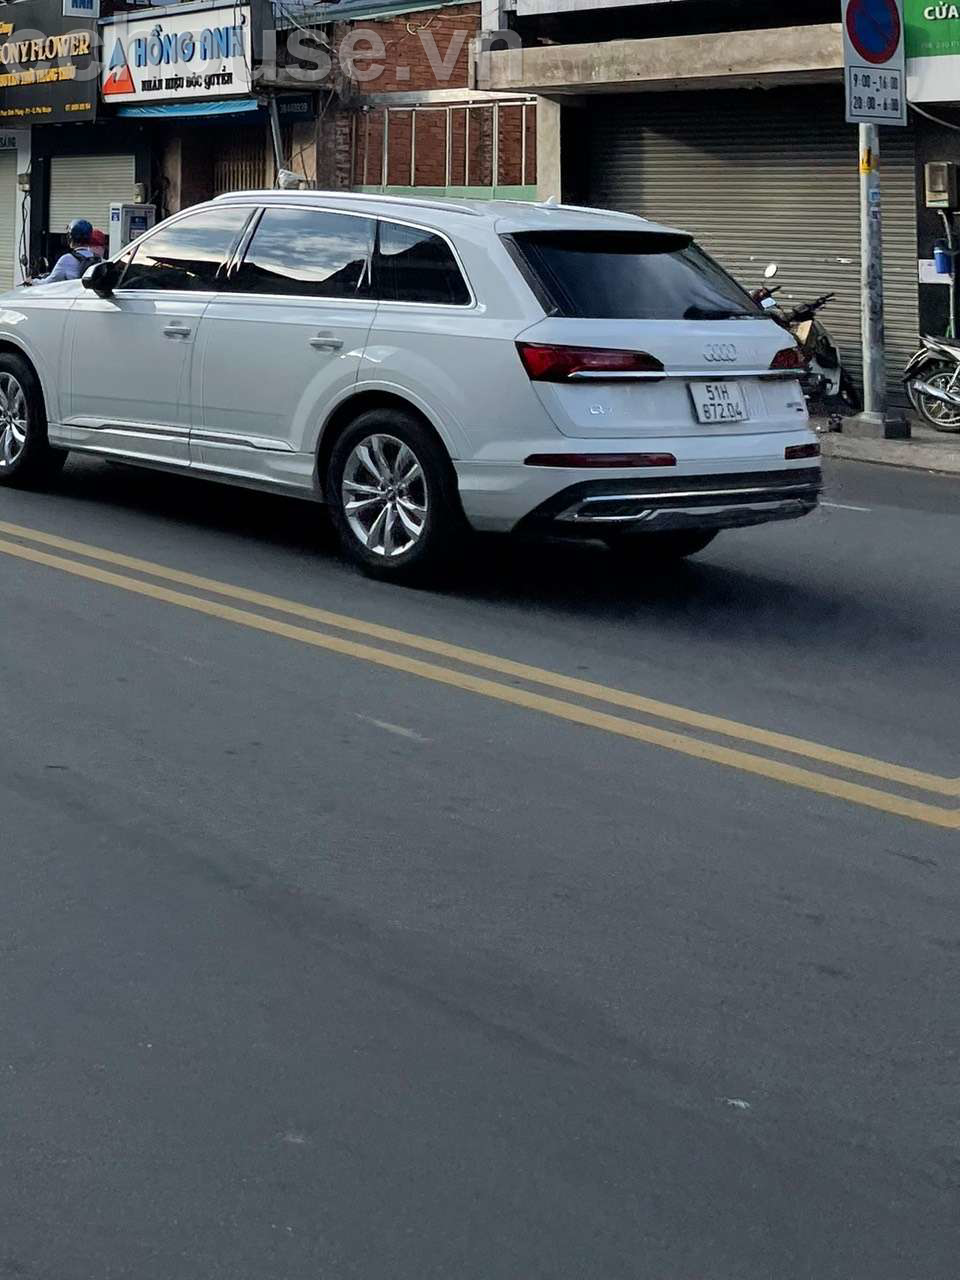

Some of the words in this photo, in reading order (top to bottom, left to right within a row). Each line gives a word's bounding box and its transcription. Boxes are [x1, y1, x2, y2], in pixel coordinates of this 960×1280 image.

[924, 1, 959, 20] CỬA
[30, 32, 91, 61] FLOWER
[135, 24, 195, 68] HỒNG
[200, 25, 246, 61] ANH
[165, 74, 184, 92] HIỆU
[705, 384, 730, 401] 51H
